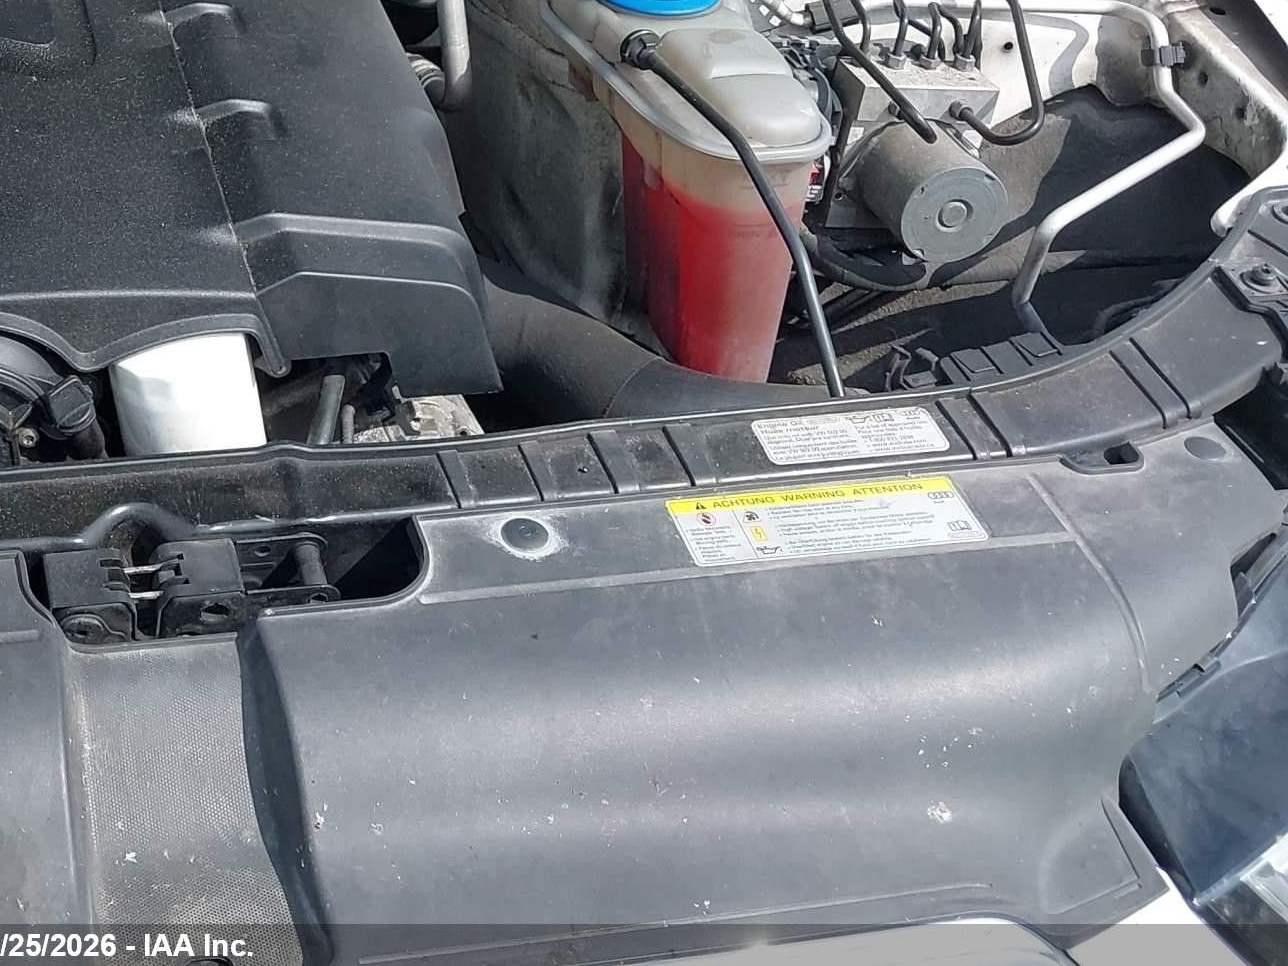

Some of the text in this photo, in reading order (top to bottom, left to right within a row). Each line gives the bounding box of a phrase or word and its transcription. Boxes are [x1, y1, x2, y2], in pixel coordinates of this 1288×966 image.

[712, 495, 776, 509] ACHTUNG
[780, 488, 846, 502] WARNING
[852, 482, 923, 496] ATTENTION
